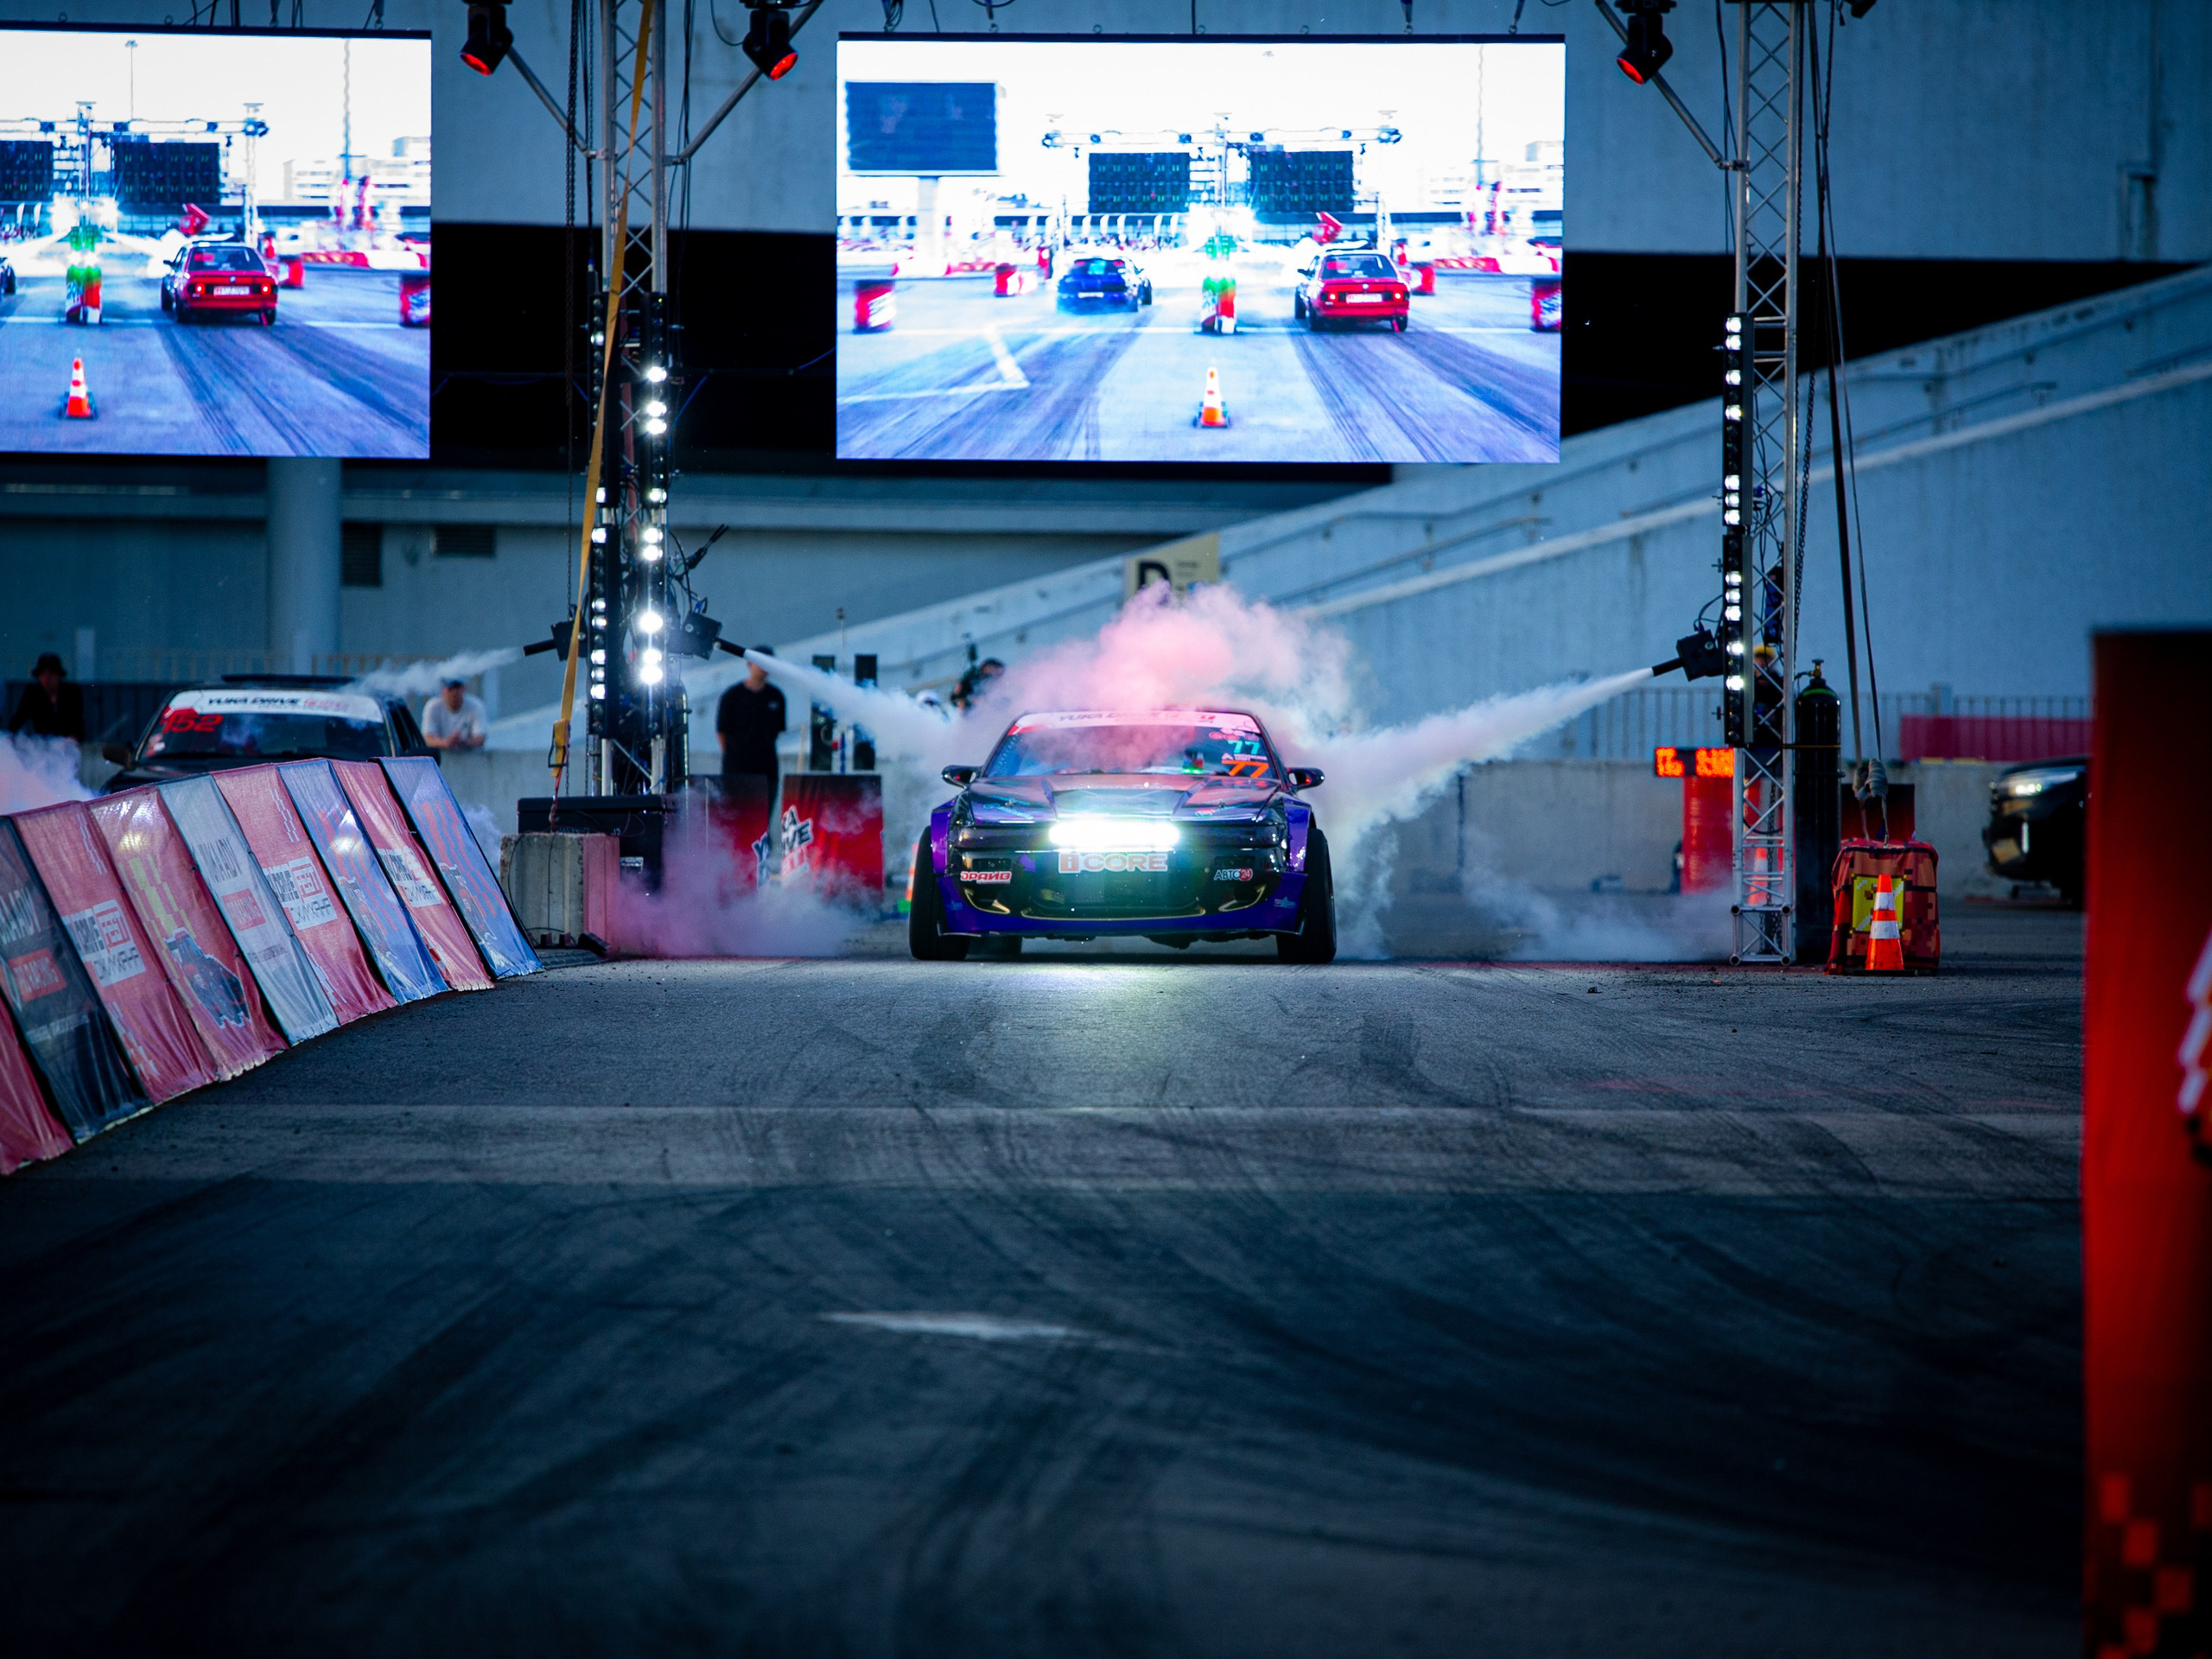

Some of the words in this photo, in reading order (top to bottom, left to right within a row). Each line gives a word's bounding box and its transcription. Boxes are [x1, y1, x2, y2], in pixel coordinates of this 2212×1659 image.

[161, 713, 224, 734] 152
[1227, 740, 1260, 754] 77
[1221, 760, 1268, 778] 77
